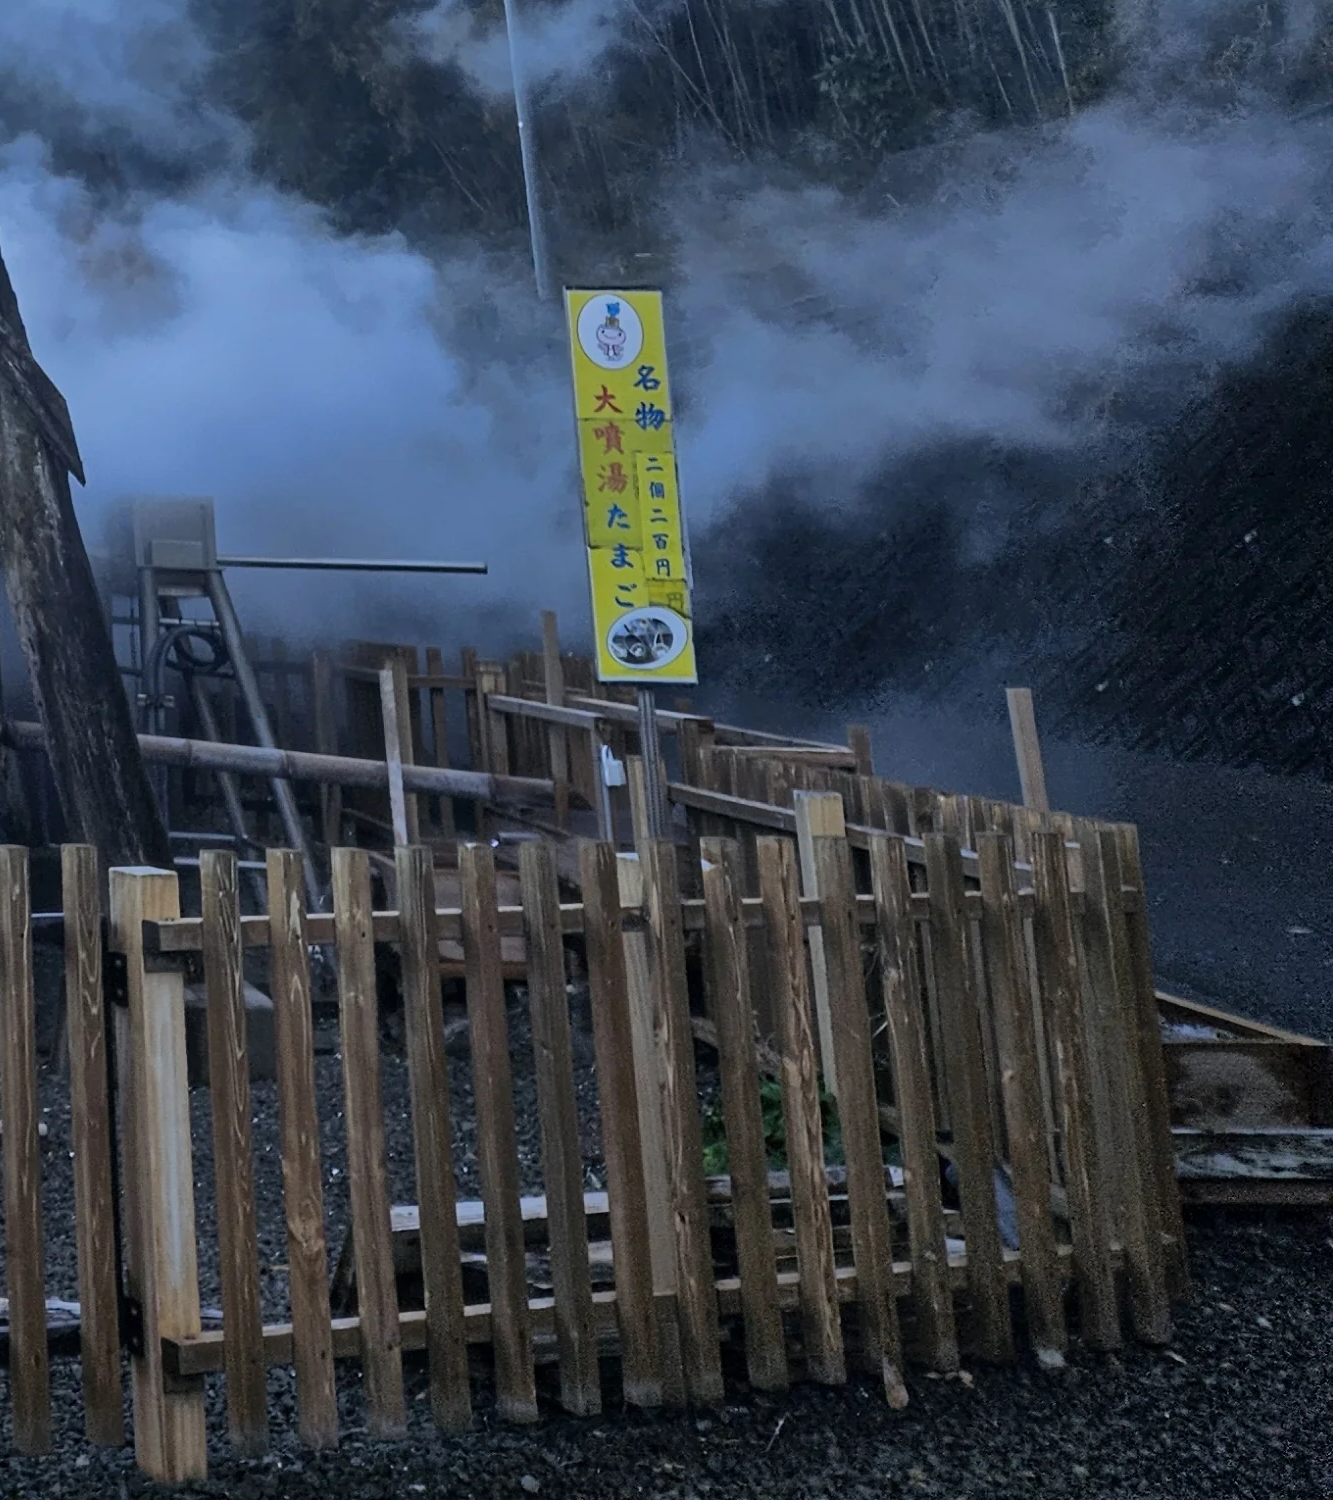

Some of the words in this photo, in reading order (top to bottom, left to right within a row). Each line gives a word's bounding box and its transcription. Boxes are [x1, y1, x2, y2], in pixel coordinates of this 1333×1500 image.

[633, 364, 665, 432] 名物
[593, 384, 637, 609] 大噴湯たまご
[646, 457, 671, 577] 二個二百円
